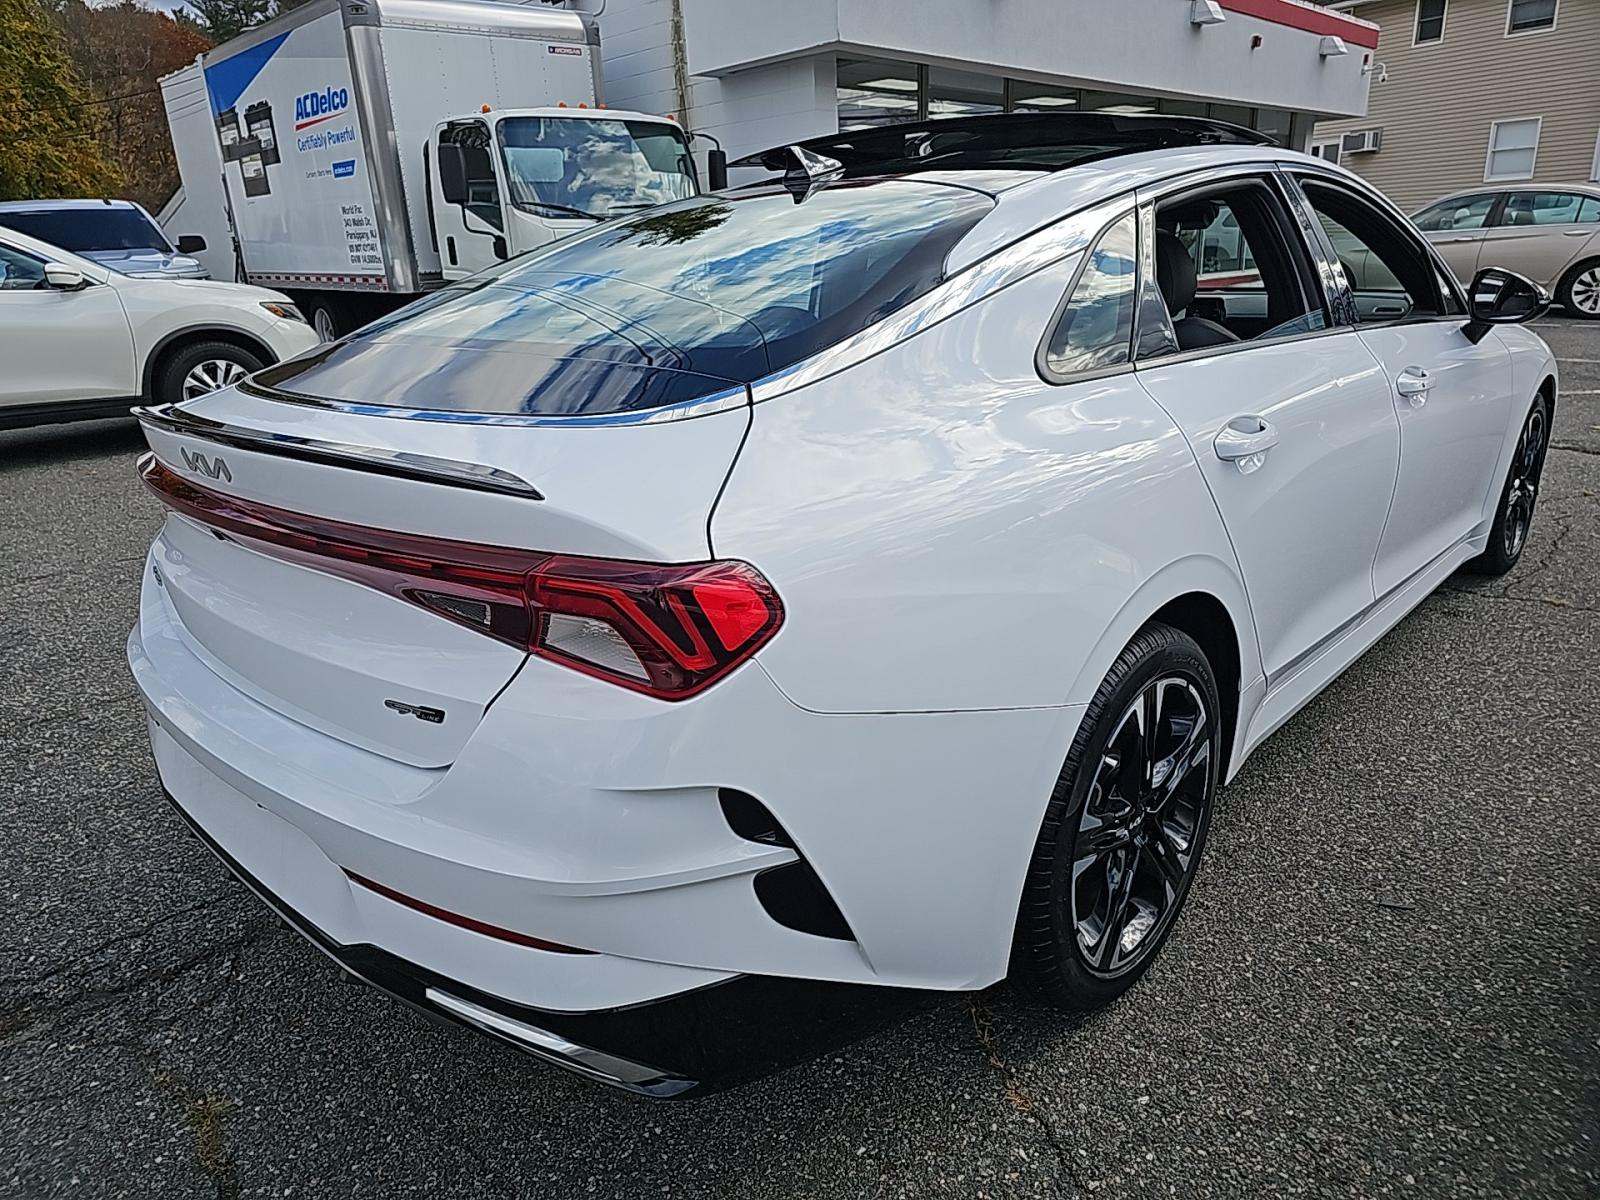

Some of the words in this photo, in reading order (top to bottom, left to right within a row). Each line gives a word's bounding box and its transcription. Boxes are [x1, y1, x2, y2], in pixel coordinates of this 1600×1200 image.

[295, 86, 348, 121] ACDelco
[297, 133, 327, 151] Certifiably
[327, 126, 356, 146] Powerful
[180, 446, 233, 483] KIA
